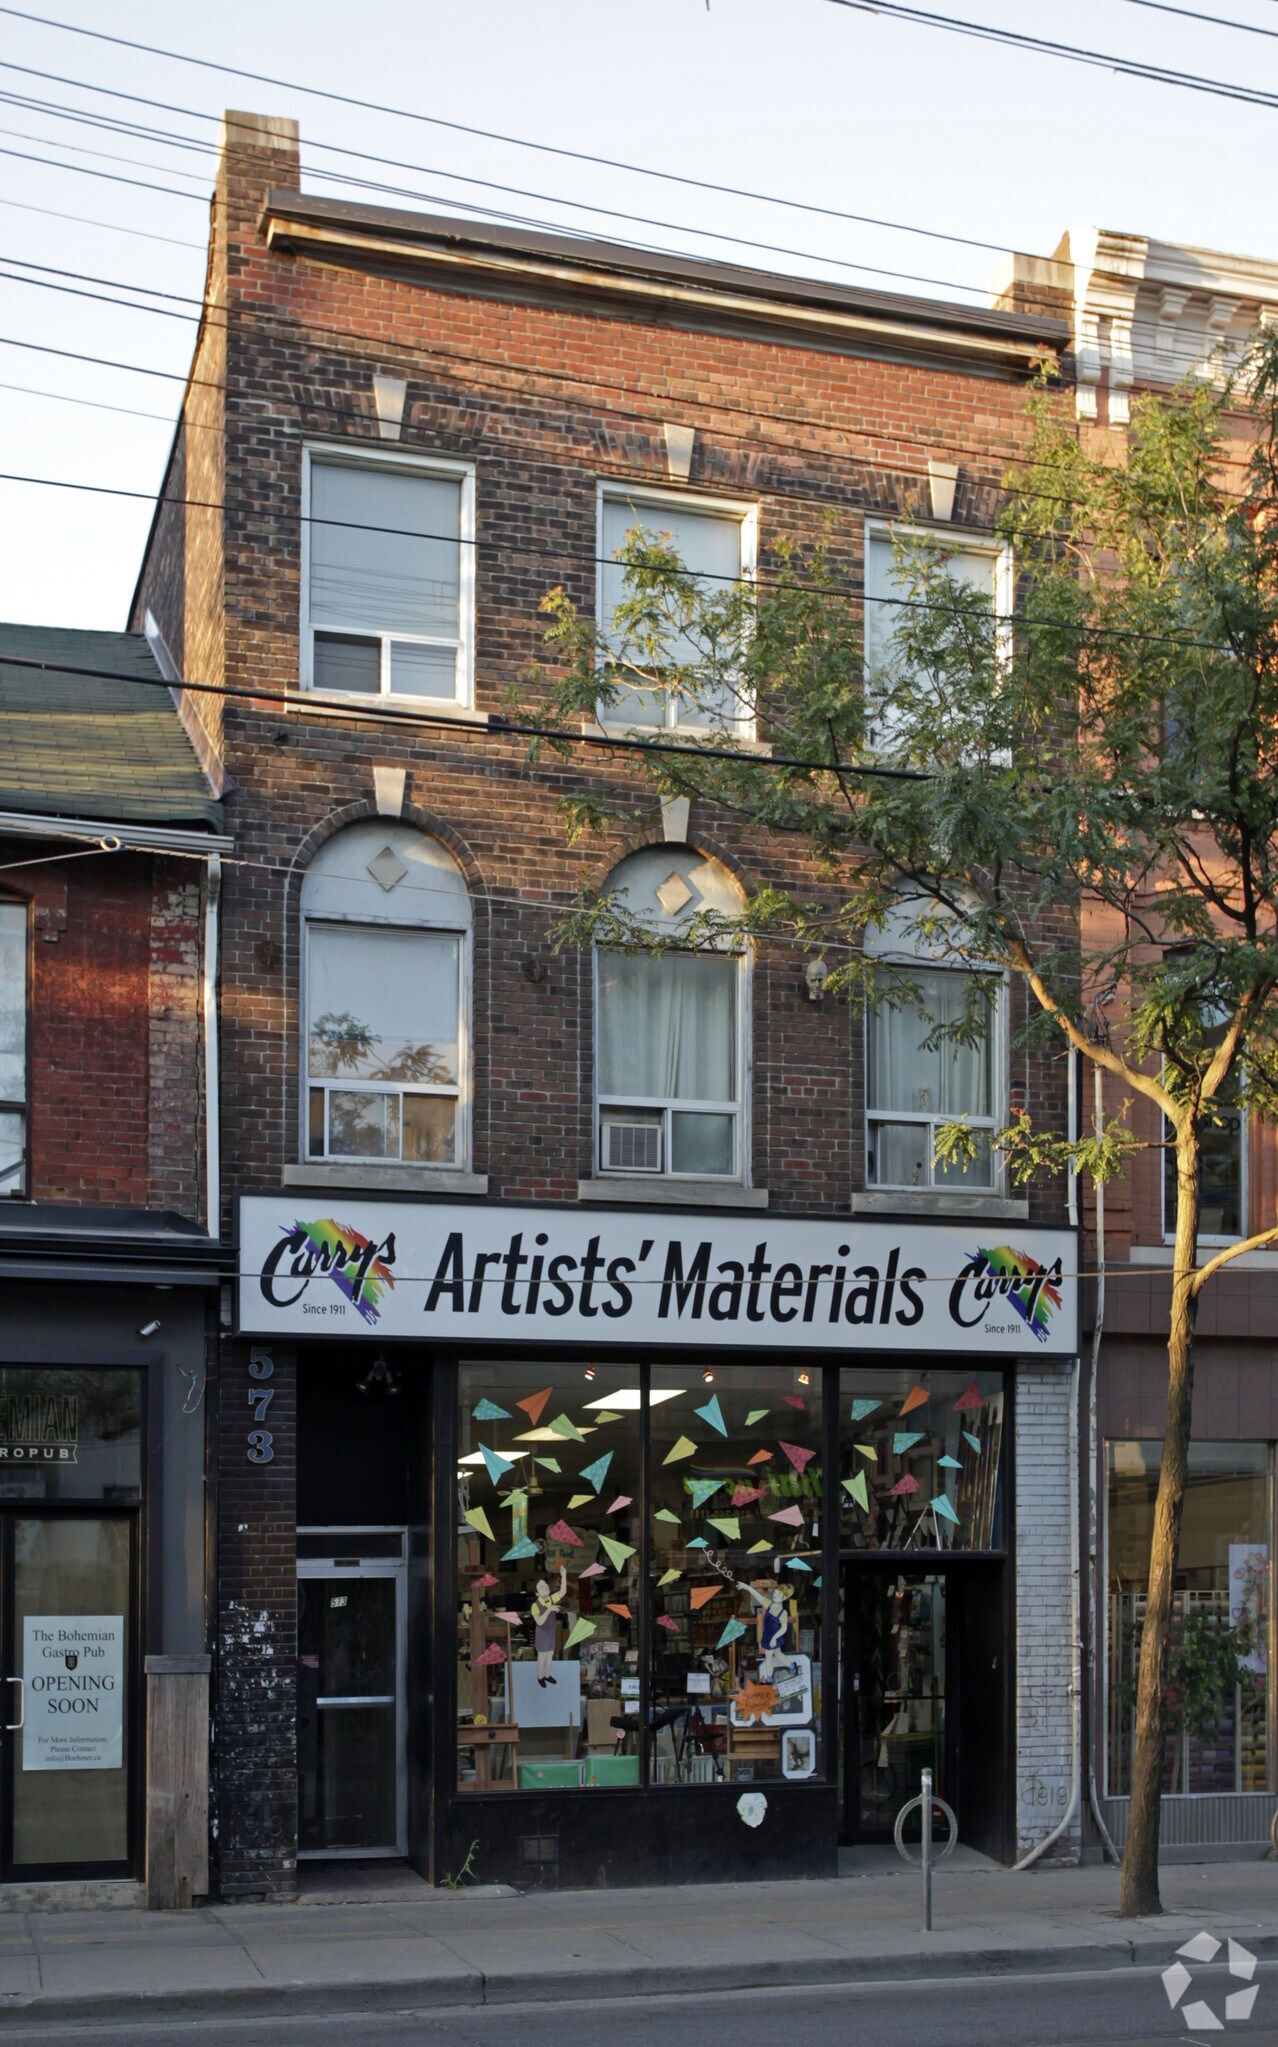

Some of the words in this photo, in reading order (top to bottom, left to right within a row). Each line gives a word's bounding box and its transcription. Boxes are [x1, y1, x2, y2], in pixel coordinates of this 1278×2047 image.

[425, 1231, 655, 1318] Artists'
[658, 1240, 926, 1326] Materials
[303, 1304, 327, 1315] Since
[330, 1305, 346, 1315] 1911
[984, 1324, 1005, 1334] Since
[1007, 1324, 1021, 1334] 1911
[331, 1597, 347, 1607] 573
[32, 1630, 54, 1642] The
[58, 1629, 115, 1641] Bohemian
[42, 1646, 80, 1658] Gastro
[84, 1646, 105, 1658] Pub
[32, 1675, 115, 1691] OPENING
[48, 1698, 99, 1714] SOON
